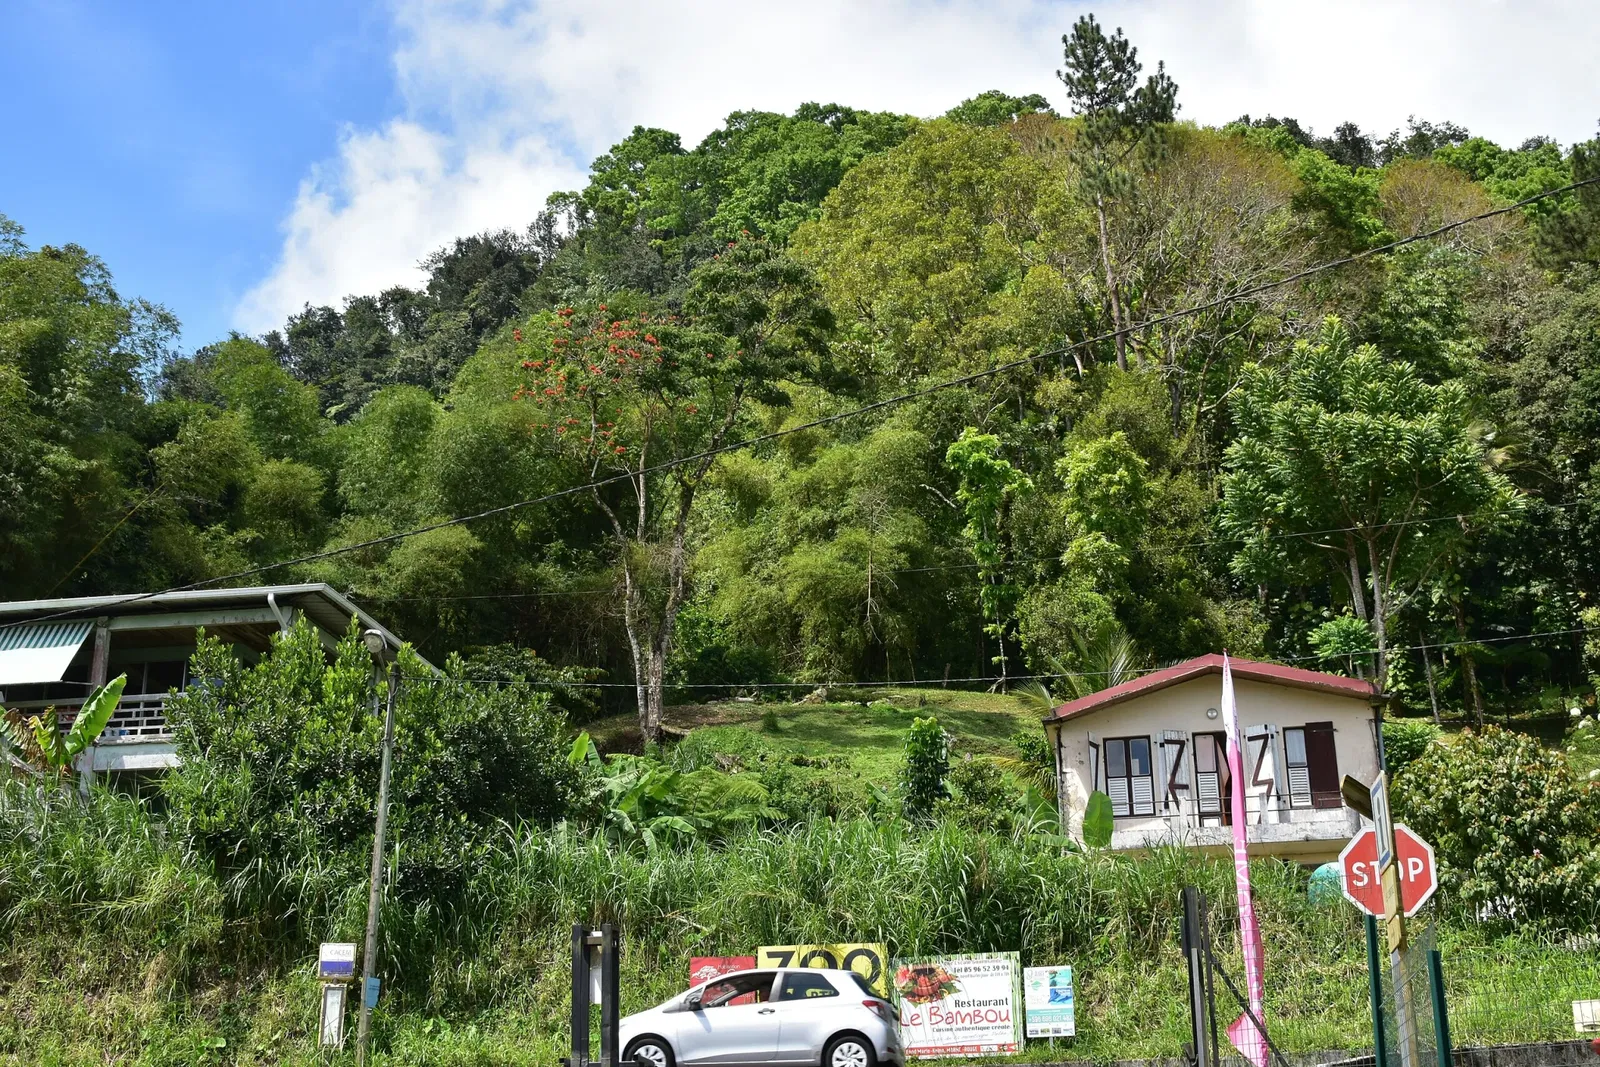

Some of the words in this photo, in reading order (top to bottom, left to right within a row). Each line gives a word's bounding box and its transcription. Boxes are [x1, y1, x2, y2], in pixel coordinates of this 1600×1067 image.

[1351, 857, 1424, 887] STP
[992, 964, 1000, 972] 39
[954, 997, 1009, 1008] Restaurant
[900, 1008, 923, 1027] Le
